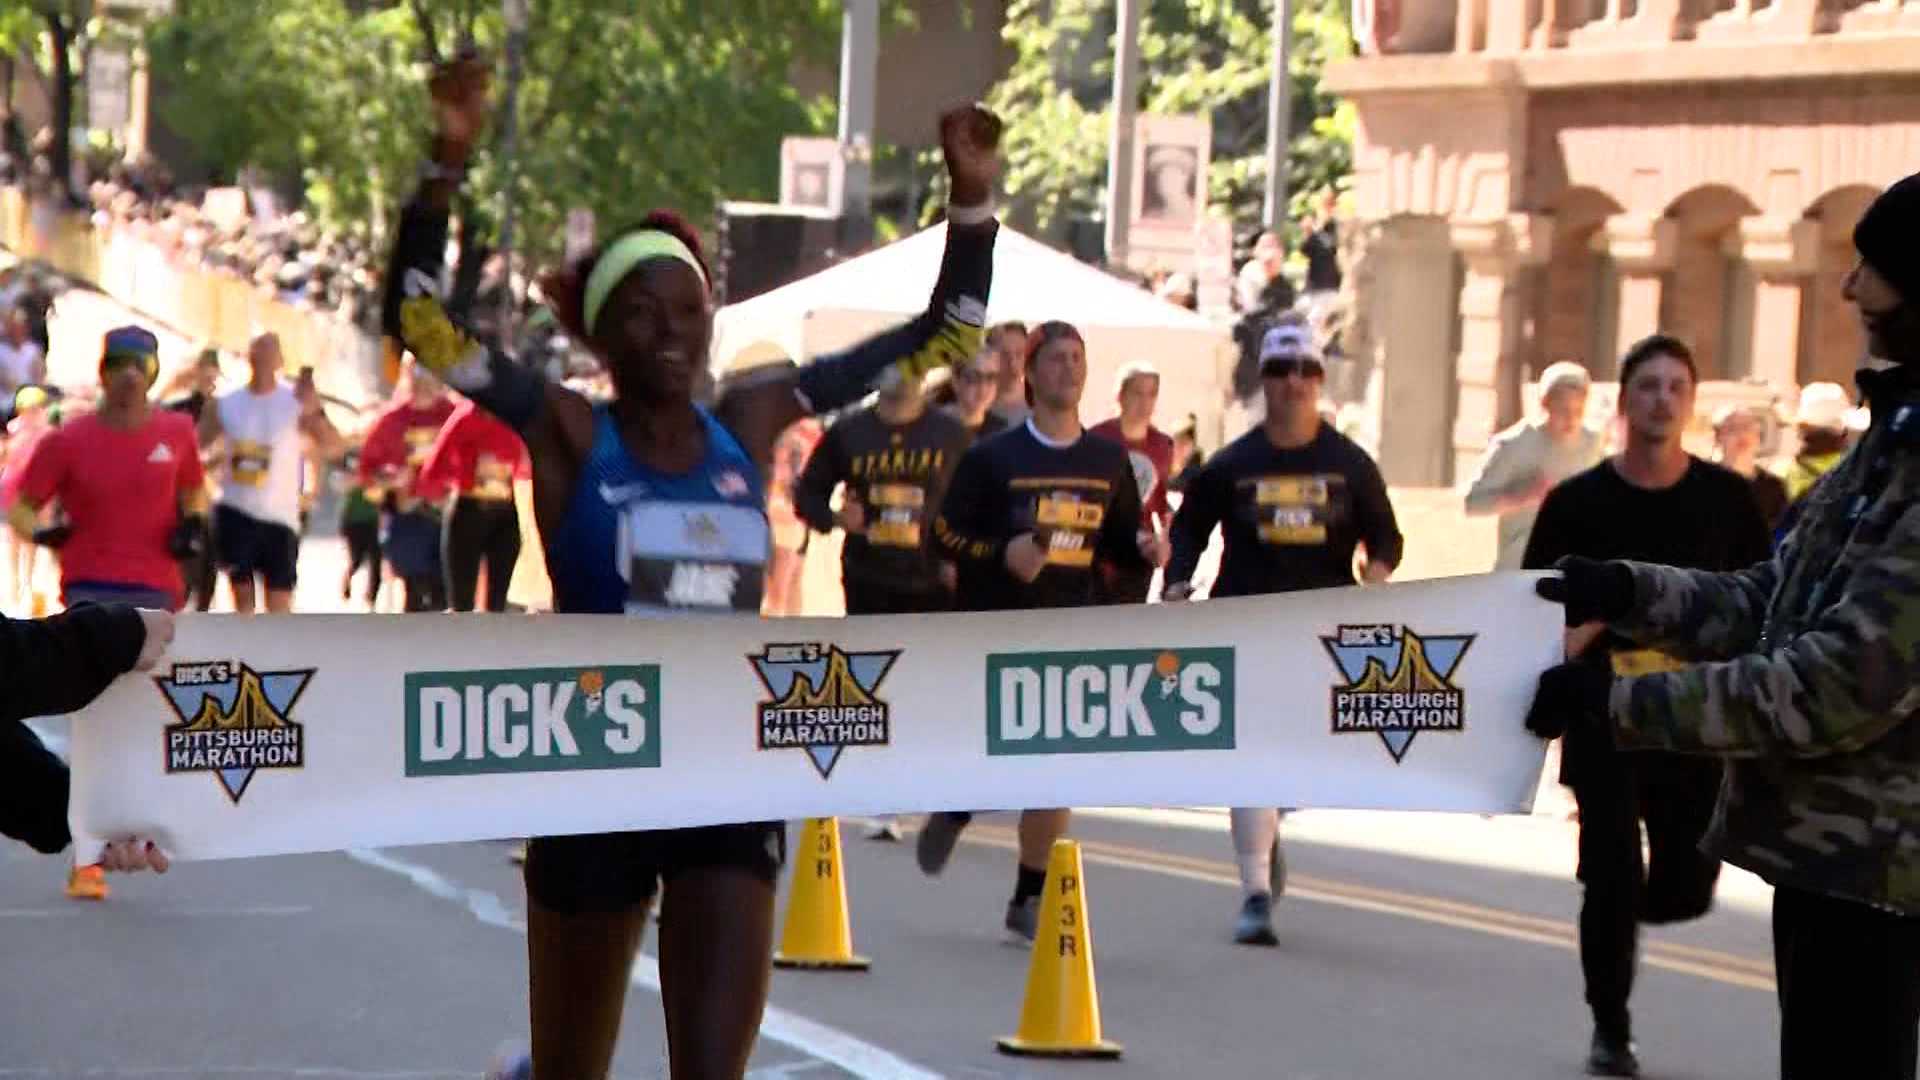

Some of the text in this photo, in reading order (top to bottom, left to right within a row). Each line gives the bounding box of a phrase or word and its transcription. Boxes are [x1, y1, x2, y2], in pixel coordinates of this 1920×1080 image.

[1000, 660, 1222, 741] DICK'S
[1337, 692, 1459, 709] PITTSBURGH
[419, 678, 647, 762] DICK'S
[763, 706, 884, 725] PITTSBURGH
[1337, 709, 1459, 728] MARATHON
[170, 727, 299, 748] PITTSBURGH
[764, 723, 884, 744] MARATHON
[171, 746, 298, 769] MARATHON
[1059, 874, 1077, 957] P3R
